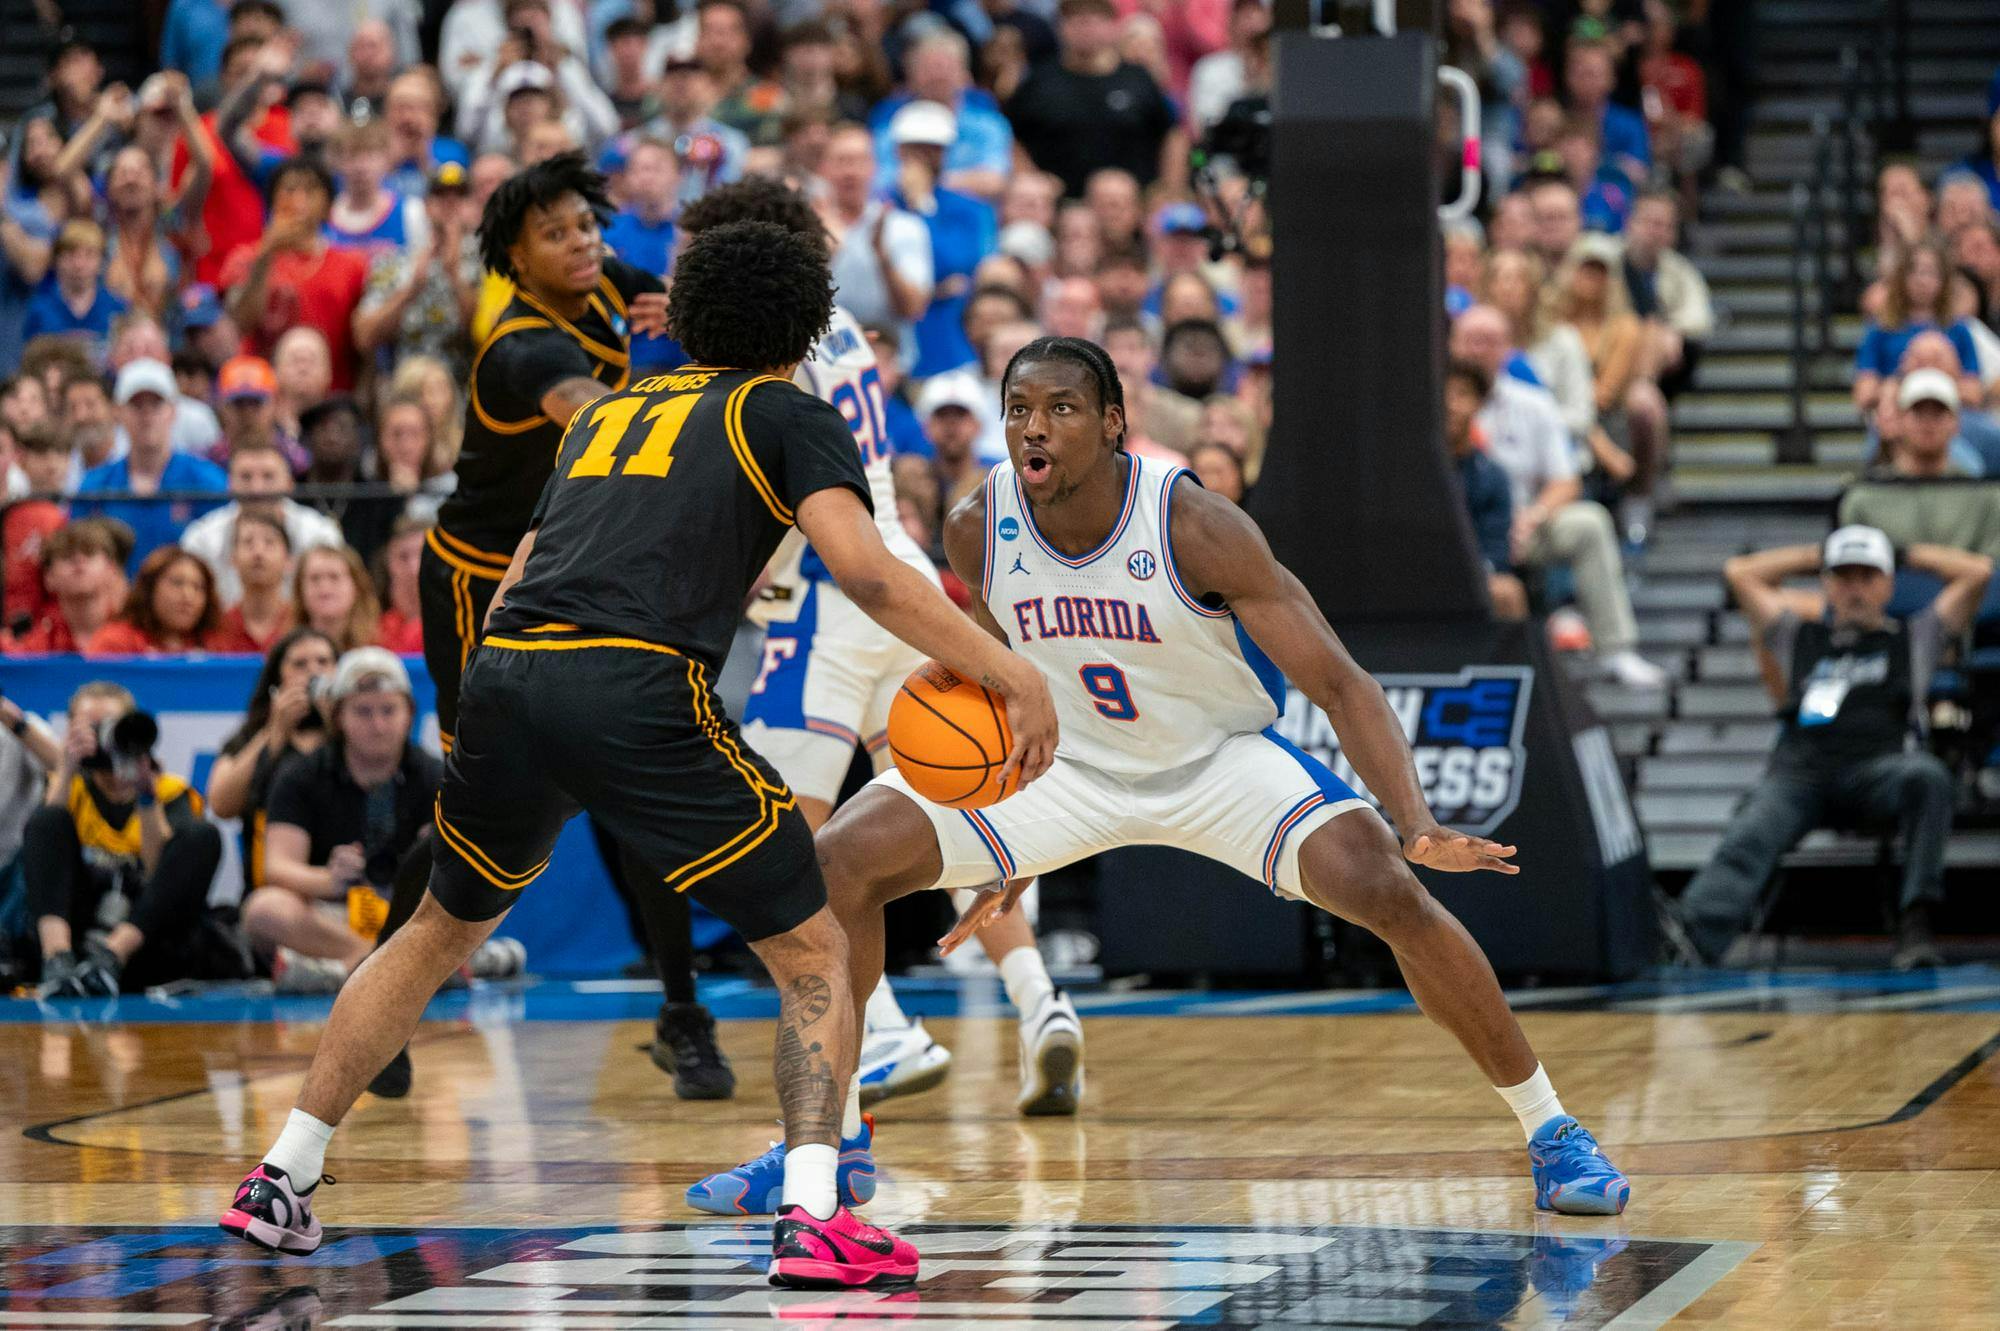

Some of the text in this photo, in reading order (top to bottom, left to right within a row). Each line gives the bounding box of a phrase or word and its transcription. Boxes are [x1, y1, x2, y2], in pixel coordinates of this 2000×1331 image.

[630, 372, 719, 393] COMBS
[567, 392, 704, 479] 11
[1000, 527, 1018, 536] NCAA
[1128, 550, 1156, 580] SEC
[1013, 595, 1162, 644] FLORIDA
[1078, 663, 1140, 722] 9
